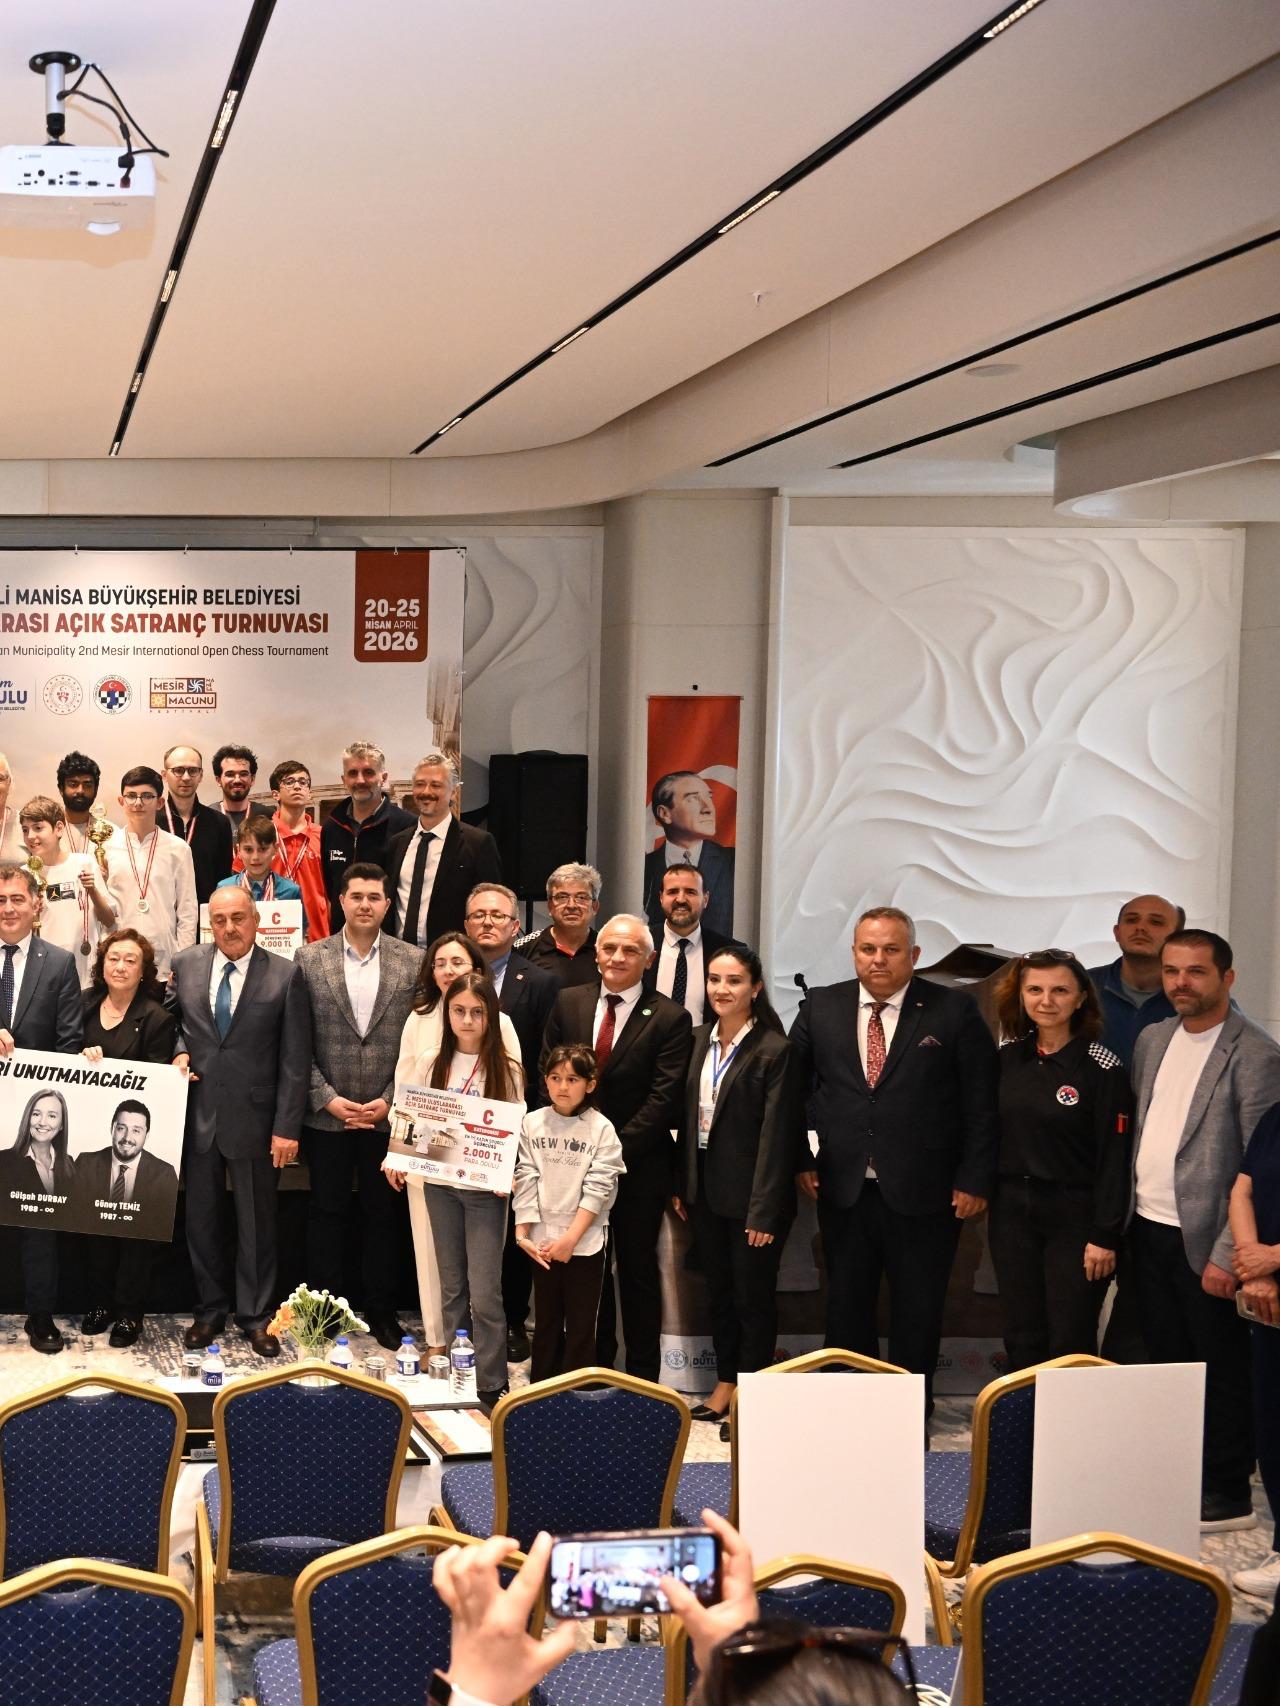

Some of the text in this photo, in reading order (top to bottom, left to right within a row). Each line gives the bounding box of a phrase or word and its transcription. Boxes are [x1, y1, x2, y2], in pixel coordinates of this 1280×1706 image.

[16, 584, 83, 605] MANİSA
[89, 584, 198, 608] BÜYÜKŞEHİR
[203, 584, 300, 605] BELEDİYESİ
[364, 598, 420, 618] 20-25
[55, 612, 106, 637] AÇIK
[111, 612, 207, 637] SATRANÇ
[211, 612, 329, 634] TURNUVASI
[365, 618, 419, 630] NİSAN APRIL
[364, 631, 419, 651] 2026
[13, 645, 76, 658] Municipality
[78, 645, 99, 656] 2nd
[101, 645, 130, 656] Mesir
[133, 645, 200, 656] International
[202, 645, 228, 658] Open
[231, 645, 264, 656] Chess
[267, 645, 329, 656] Tournament
[153, 681, 185, 690] MESİR
[168, 697, 214, 705] MACUNU
[272, 912, 280, 925] C
[13, 1062, 147, 1091] UNUTMAYACAĞIZ
[483, 1109, 494, 1125] C
[531, 1137, 558, 1149] NEW
[463, 1147, 502, 1162] 2.000 TL
[10, 1191, 67, 1204] Gülşah DURBAY
[20, 1204, 38, 1213] 1988
[119, 1201, 140, 1212] TEMİZ
[100, 1212, 117, 1221] 1987
[693, 1357, 717, 1365] DUTL
[207, 1376, 222, 1385] mila
